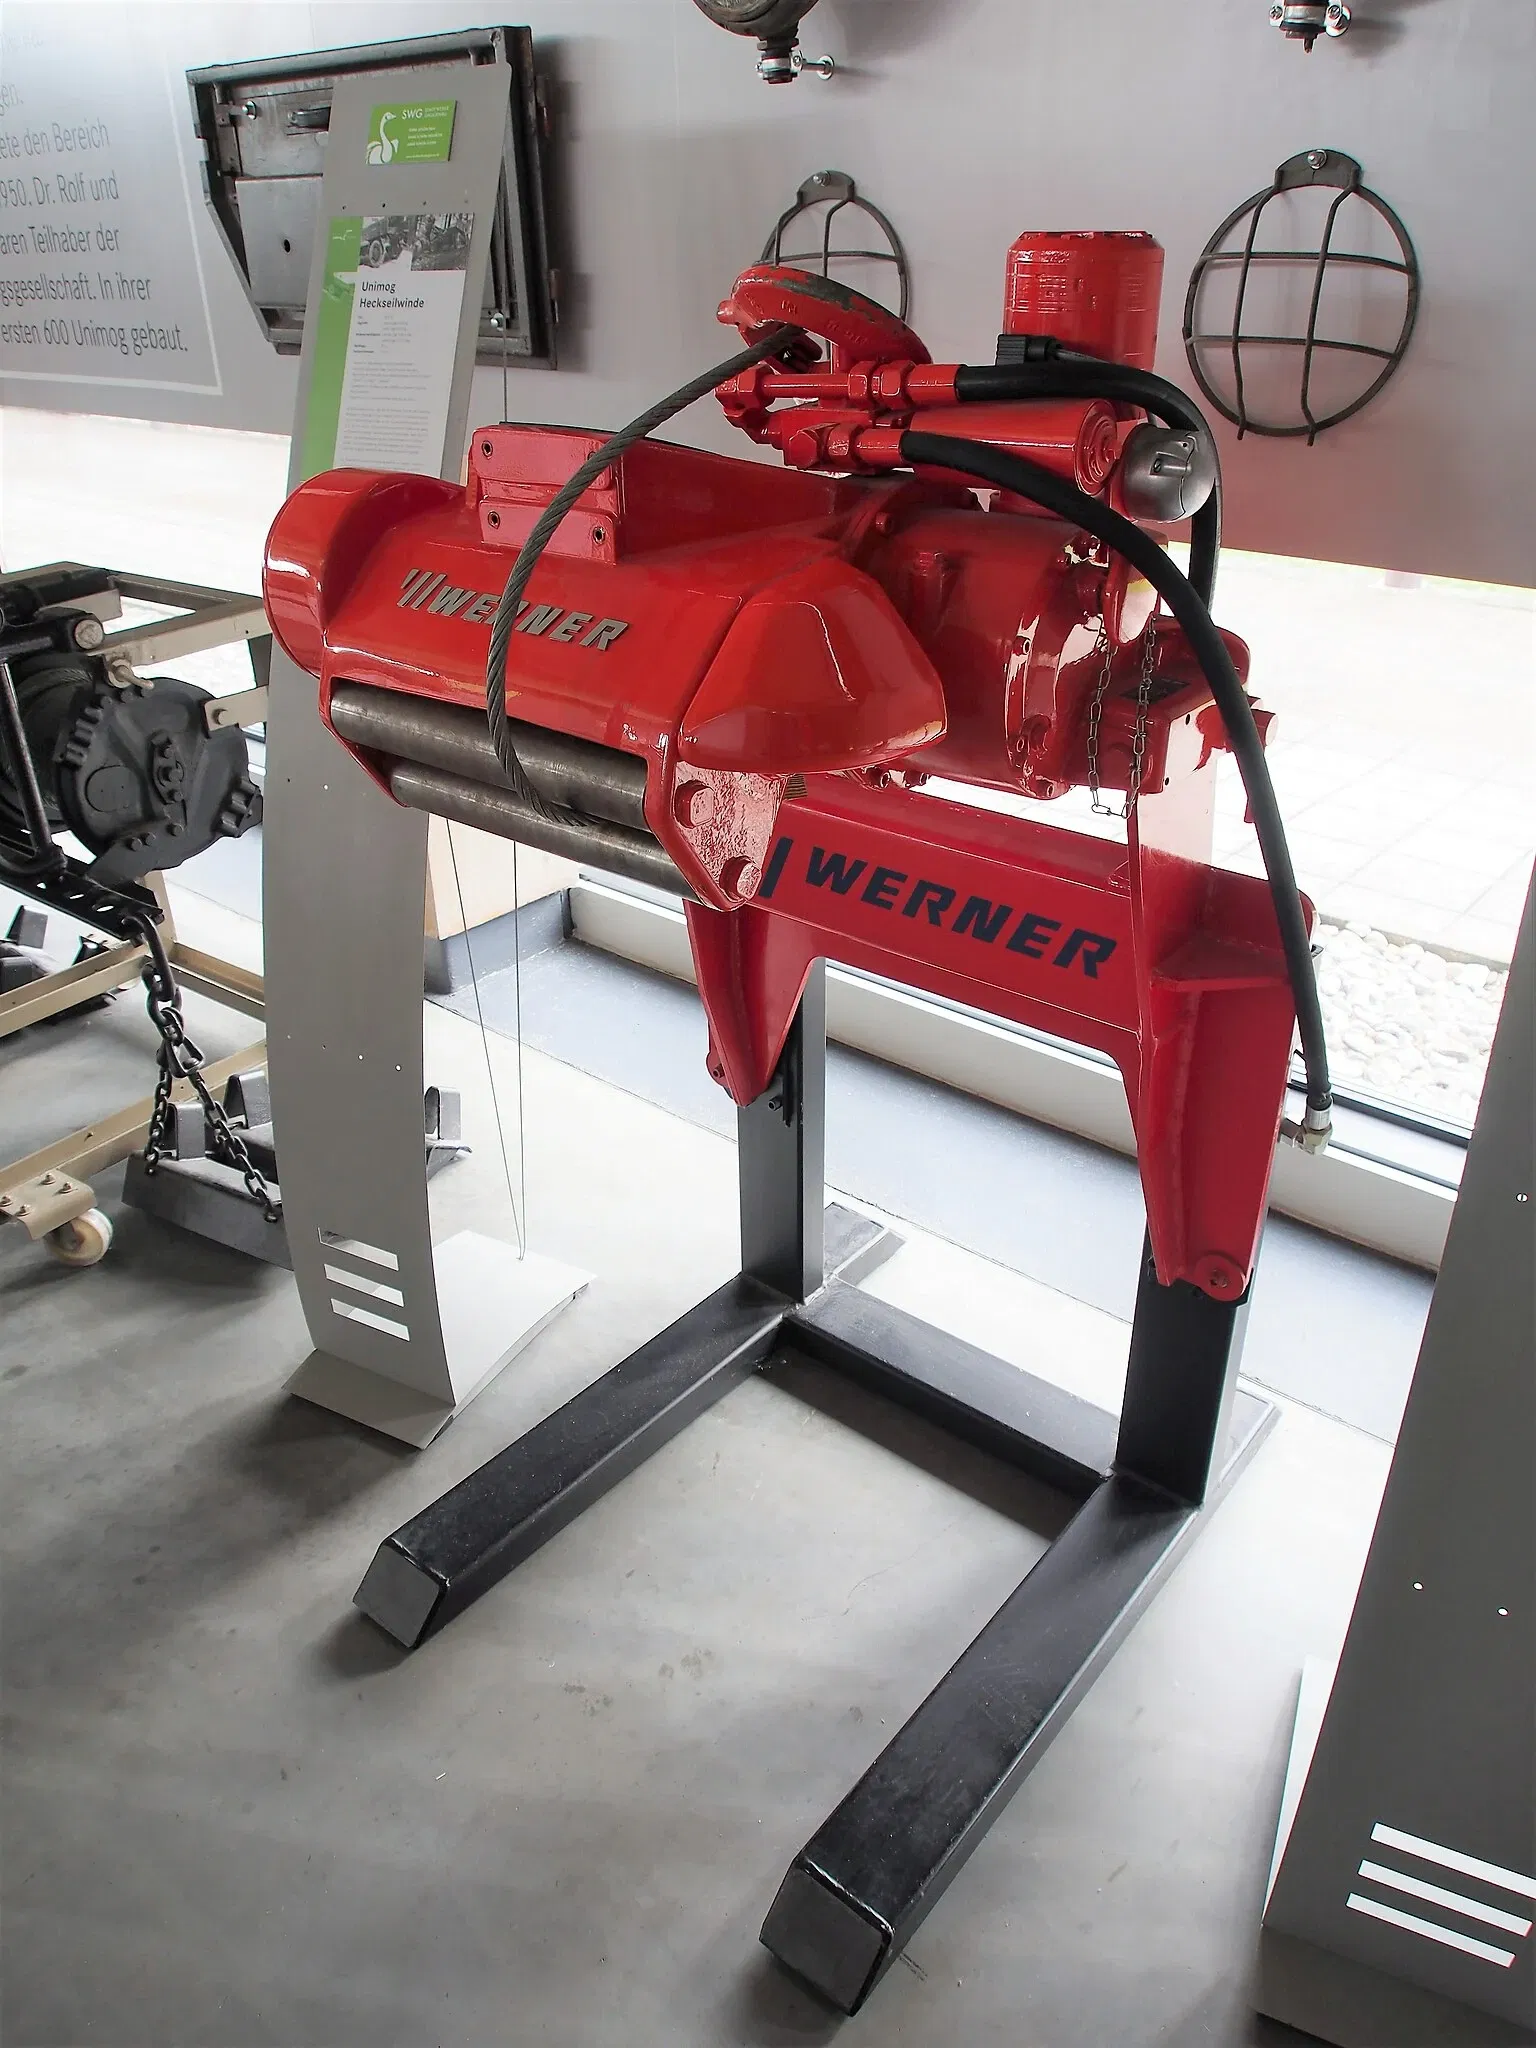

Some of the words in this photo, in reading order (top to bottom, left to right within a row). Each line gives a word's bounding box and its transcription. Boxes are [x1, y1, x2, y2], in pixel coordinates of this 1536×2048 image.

[401, 108, 423, 120] SWG
[0, 132, 21, 159] ete
[24, 128, 51, 157] den
[52, 117, 110, 153] Bereich
[33, 174, 56, 205] Dr.
[57, 171, 87, 204] Rolf
[90, 168, 121, 203] und
[28, 223, 93, 255] Teilhaber
[96, 220, 121, 252] der
[97, 271, 115, 301] In
[116, 271, 152, 301] ihrer
[359, 297, 425, 309] Heckseilwinde
[361, 281, 397, 295] Unimog
[1, 319, 41, 345] ersten
[43, 317, 70, 346] 600
[70, 319, 130, 356] Unimog
[131, 320, 189, 357] gebaut.
[805, 846, 1118, 981] WERNER
